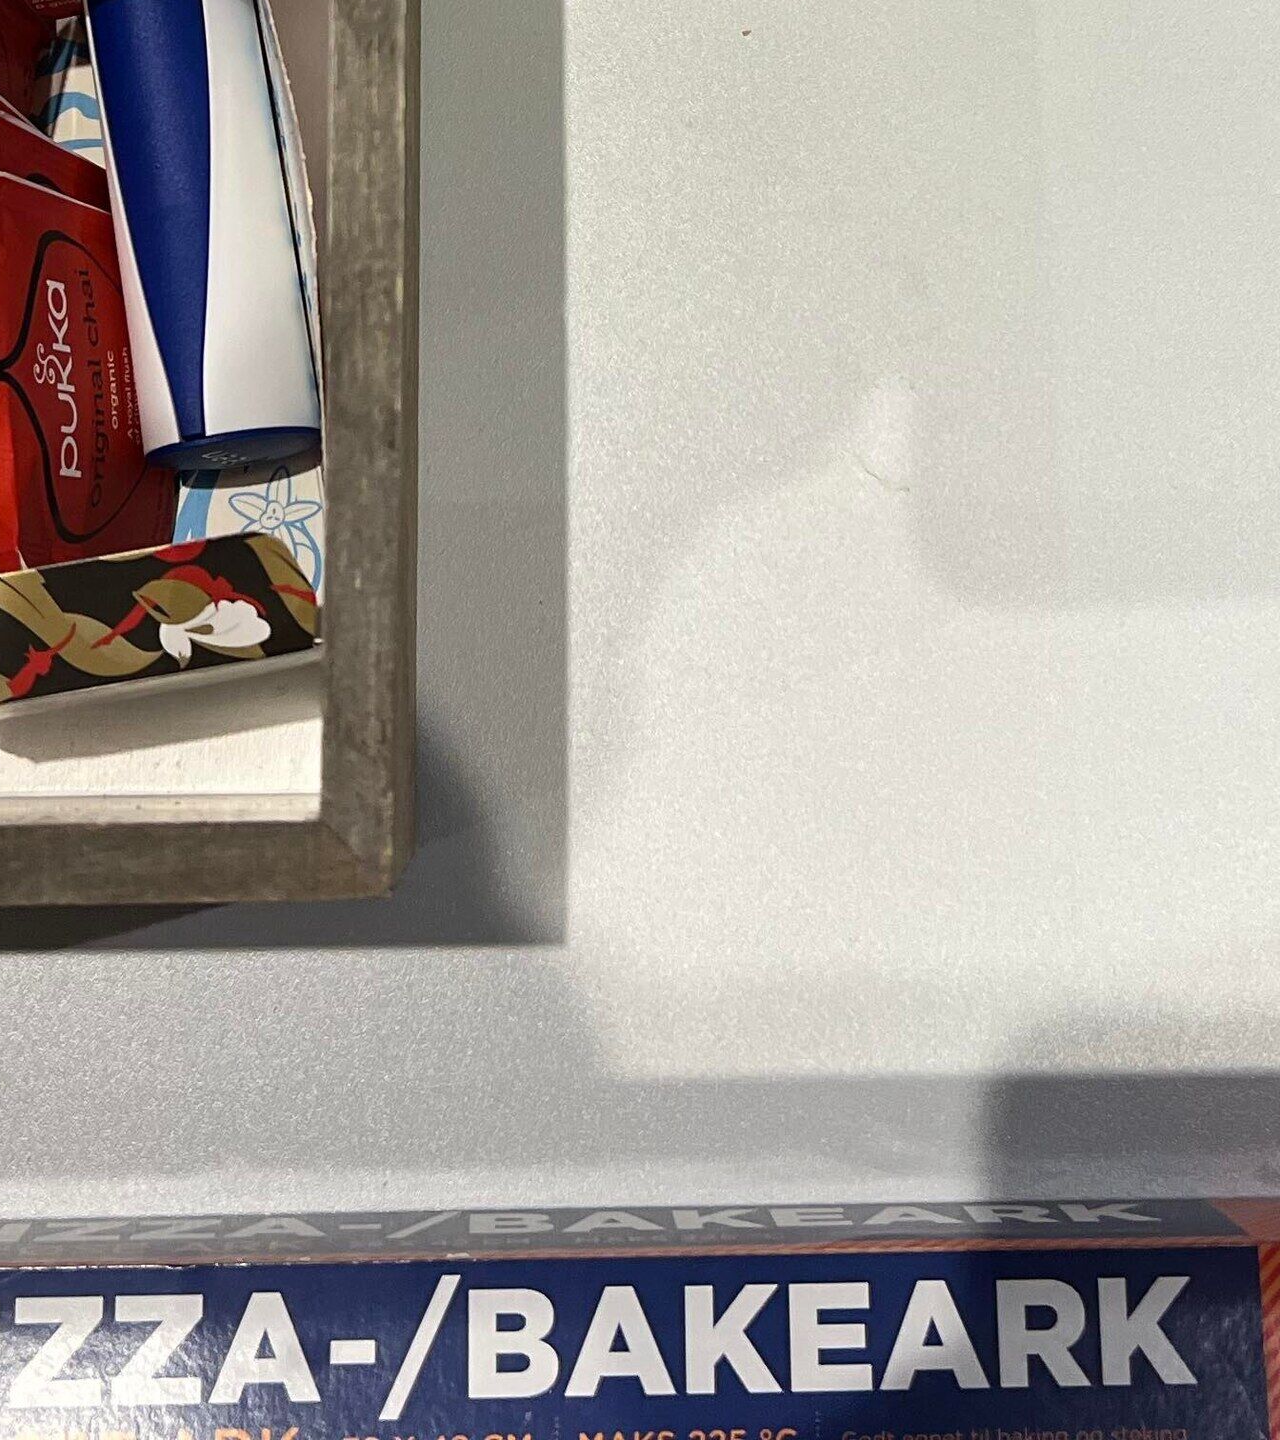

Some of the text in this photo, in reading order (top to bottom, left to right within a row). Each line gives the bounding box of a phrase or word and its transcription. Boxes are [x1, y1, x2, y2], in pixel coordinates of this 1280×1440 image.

[33, 279, 82, 479] pukka
[75, 269, 110, 509] original chai
[107, 350, 119, 430] organic
